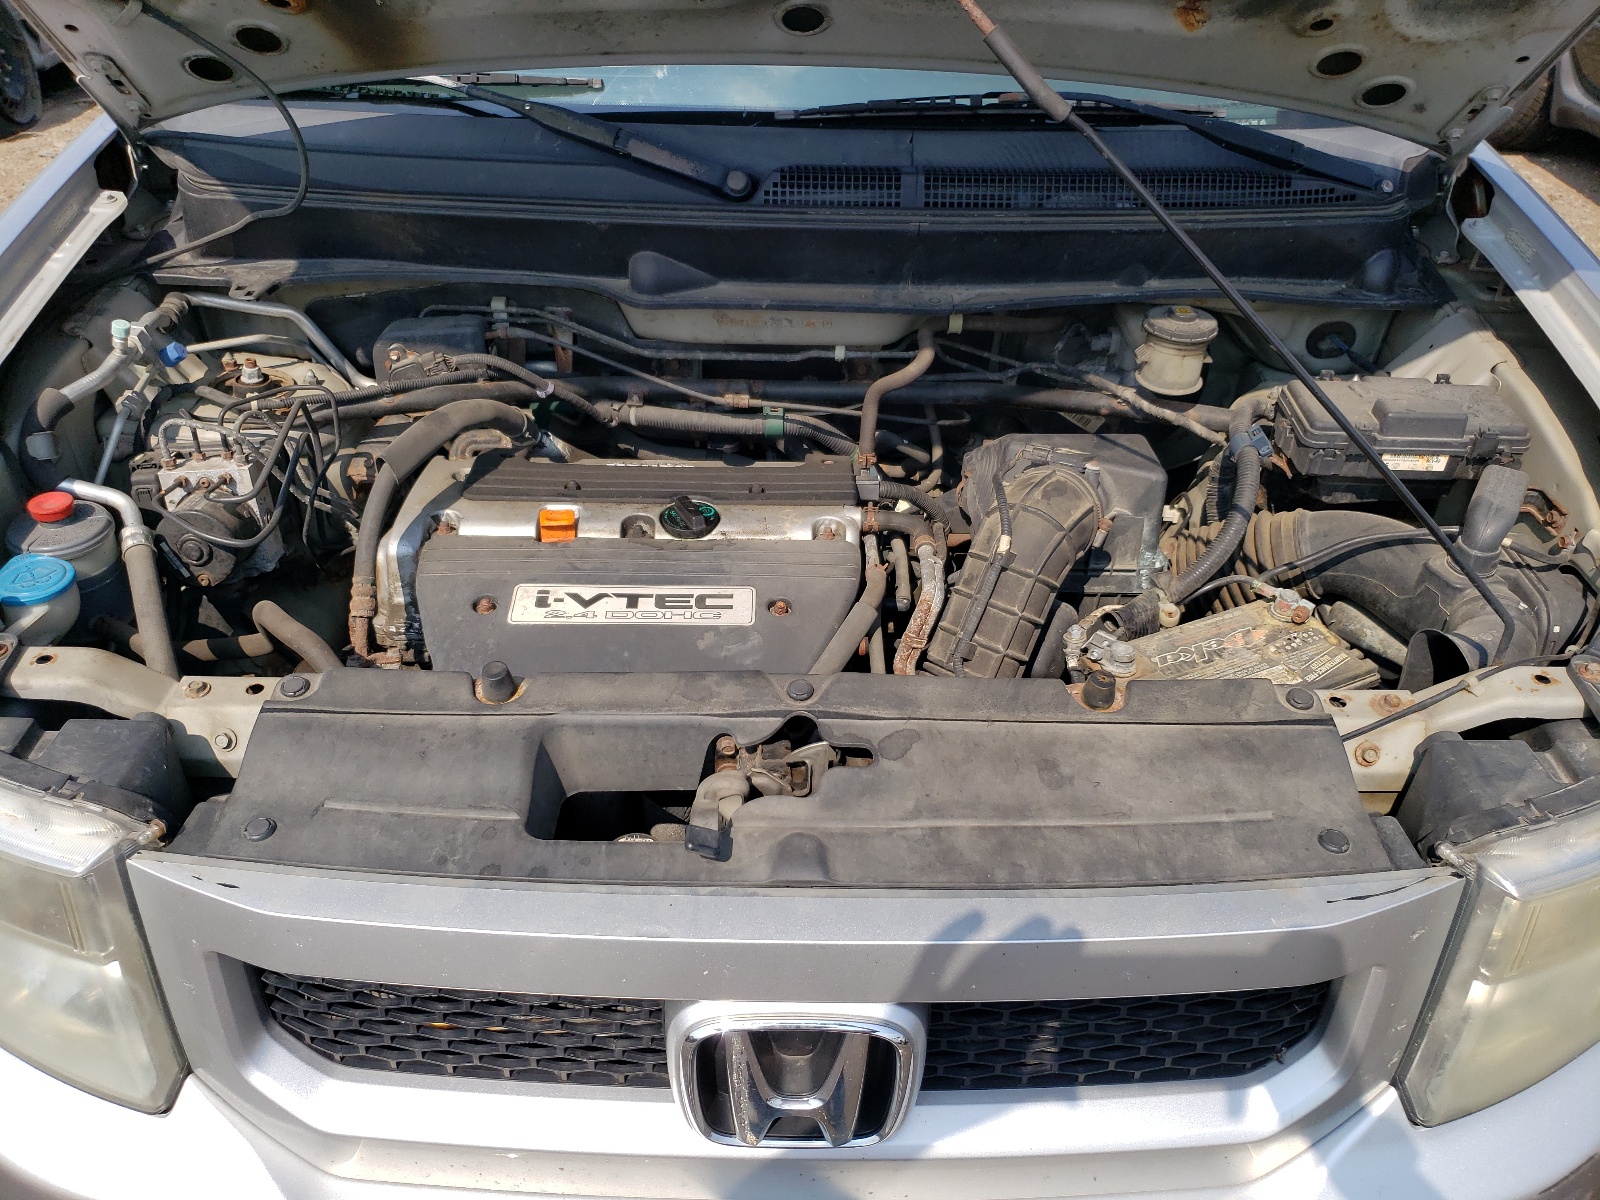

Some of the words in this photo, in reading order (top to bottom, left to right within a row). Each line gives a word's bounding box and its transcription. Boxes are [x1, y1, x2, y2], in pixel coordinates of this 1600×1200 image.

[534, 589, 734, 610] i-VTEC
[543, 610, 598, 620] 2.4
[604, 610, 723, 620] DOHC
